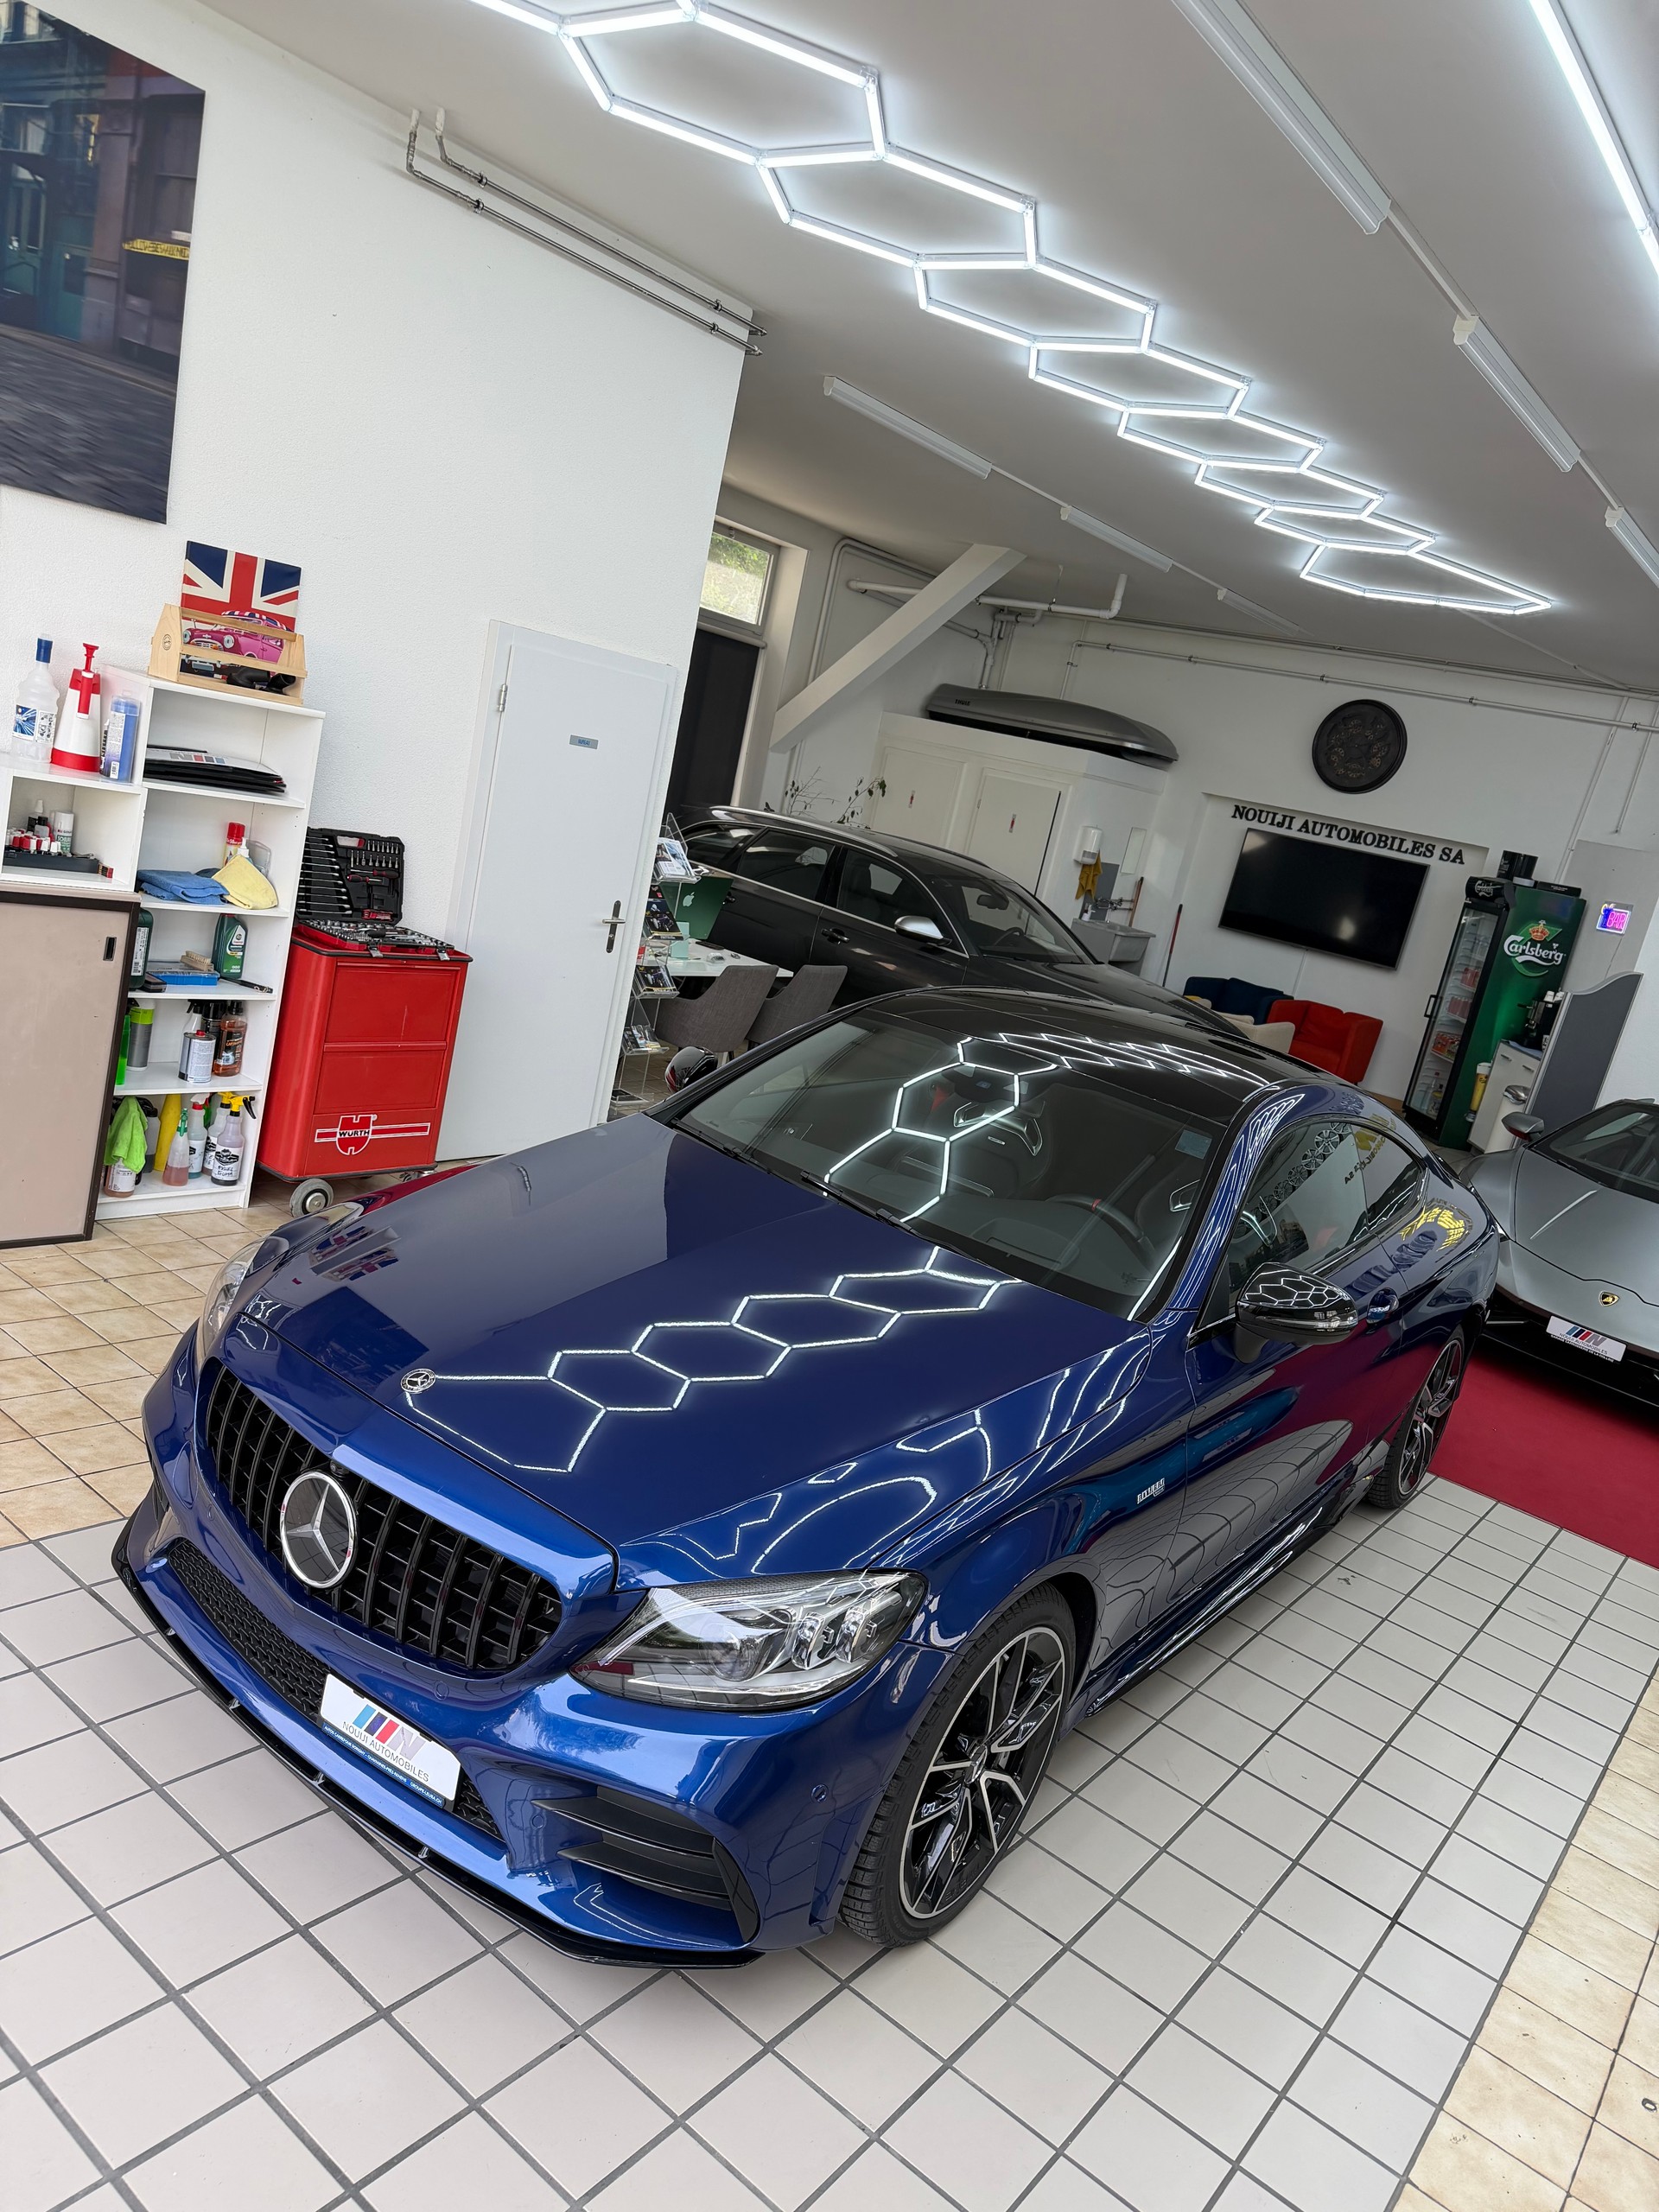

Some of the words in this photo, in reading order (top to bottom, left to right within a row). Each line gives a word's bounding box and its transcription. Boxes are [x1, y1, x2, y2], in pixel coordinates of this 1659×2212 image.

[1231, 804, 1296, 830] NOUIJI
[1297, 819, 1436, 858] AUTOMOBILES
[1439, 846, 1465, 865] SA
[1606, 912, 1628, 930] BAR
[1503, 934, 1565, 966] Carlsberg
[1575, 1338, 1608, 1355] AUTOMOBILES
[342, 1721, 368, 1744] NOUIJI
[370, 1739, 430, 1783] AUTOMOBILES
